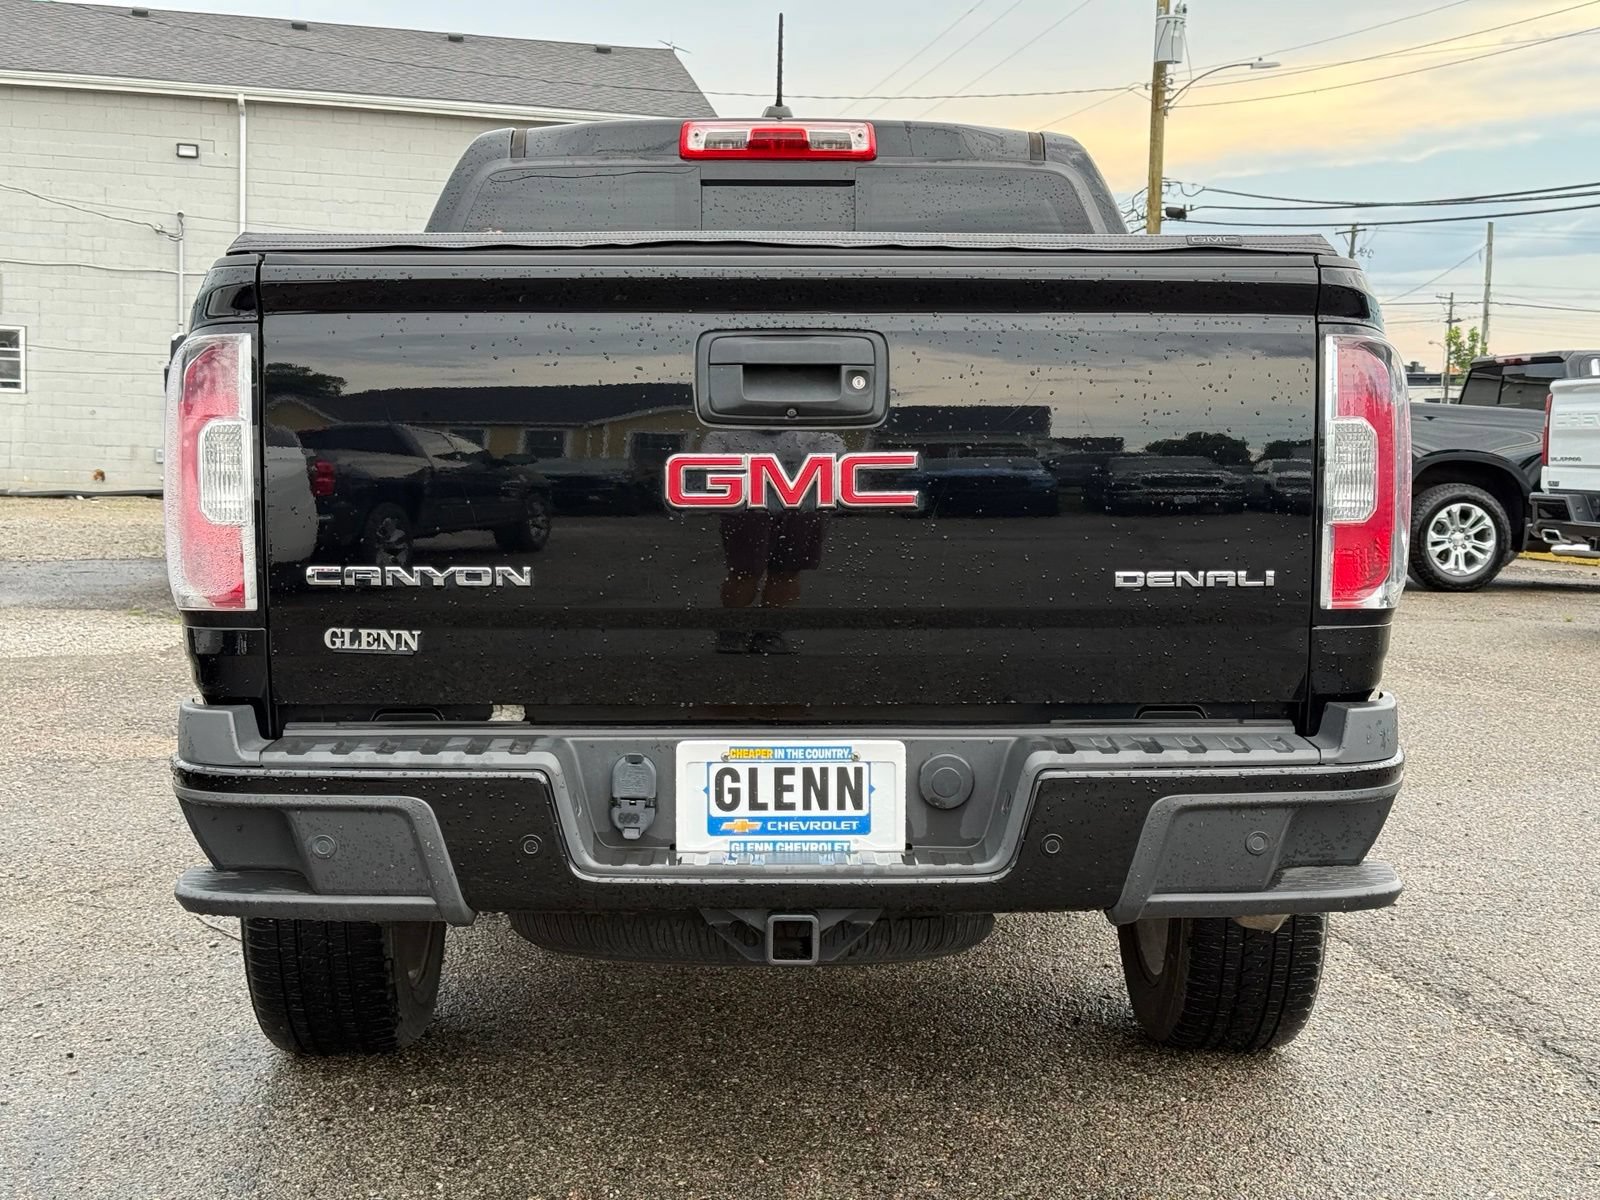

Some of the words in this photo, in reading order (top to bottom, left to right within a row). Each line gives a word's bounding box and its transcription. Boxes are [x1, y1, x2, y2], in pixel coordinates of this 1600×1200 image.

[1190, 235, 1238, 244] GMC
[665, 451, 919, 510] GMC
[305, 566, 532, 586] CANYON
[1114, 570, 1275, 588] DENALI
[324, 627, 422, 652] GLENN
[729, 748, 773, 759] CHEAPER
[774, 748, 784, 759] IN
[786, 748, 806, 759] THE
[714, 766, 864, 812] GLENN
[767, 820, 860, 831] CHEVROLET
[730, 842, 774, 851] GLENN
[775, 842, 850, 851] CHEVROLET
